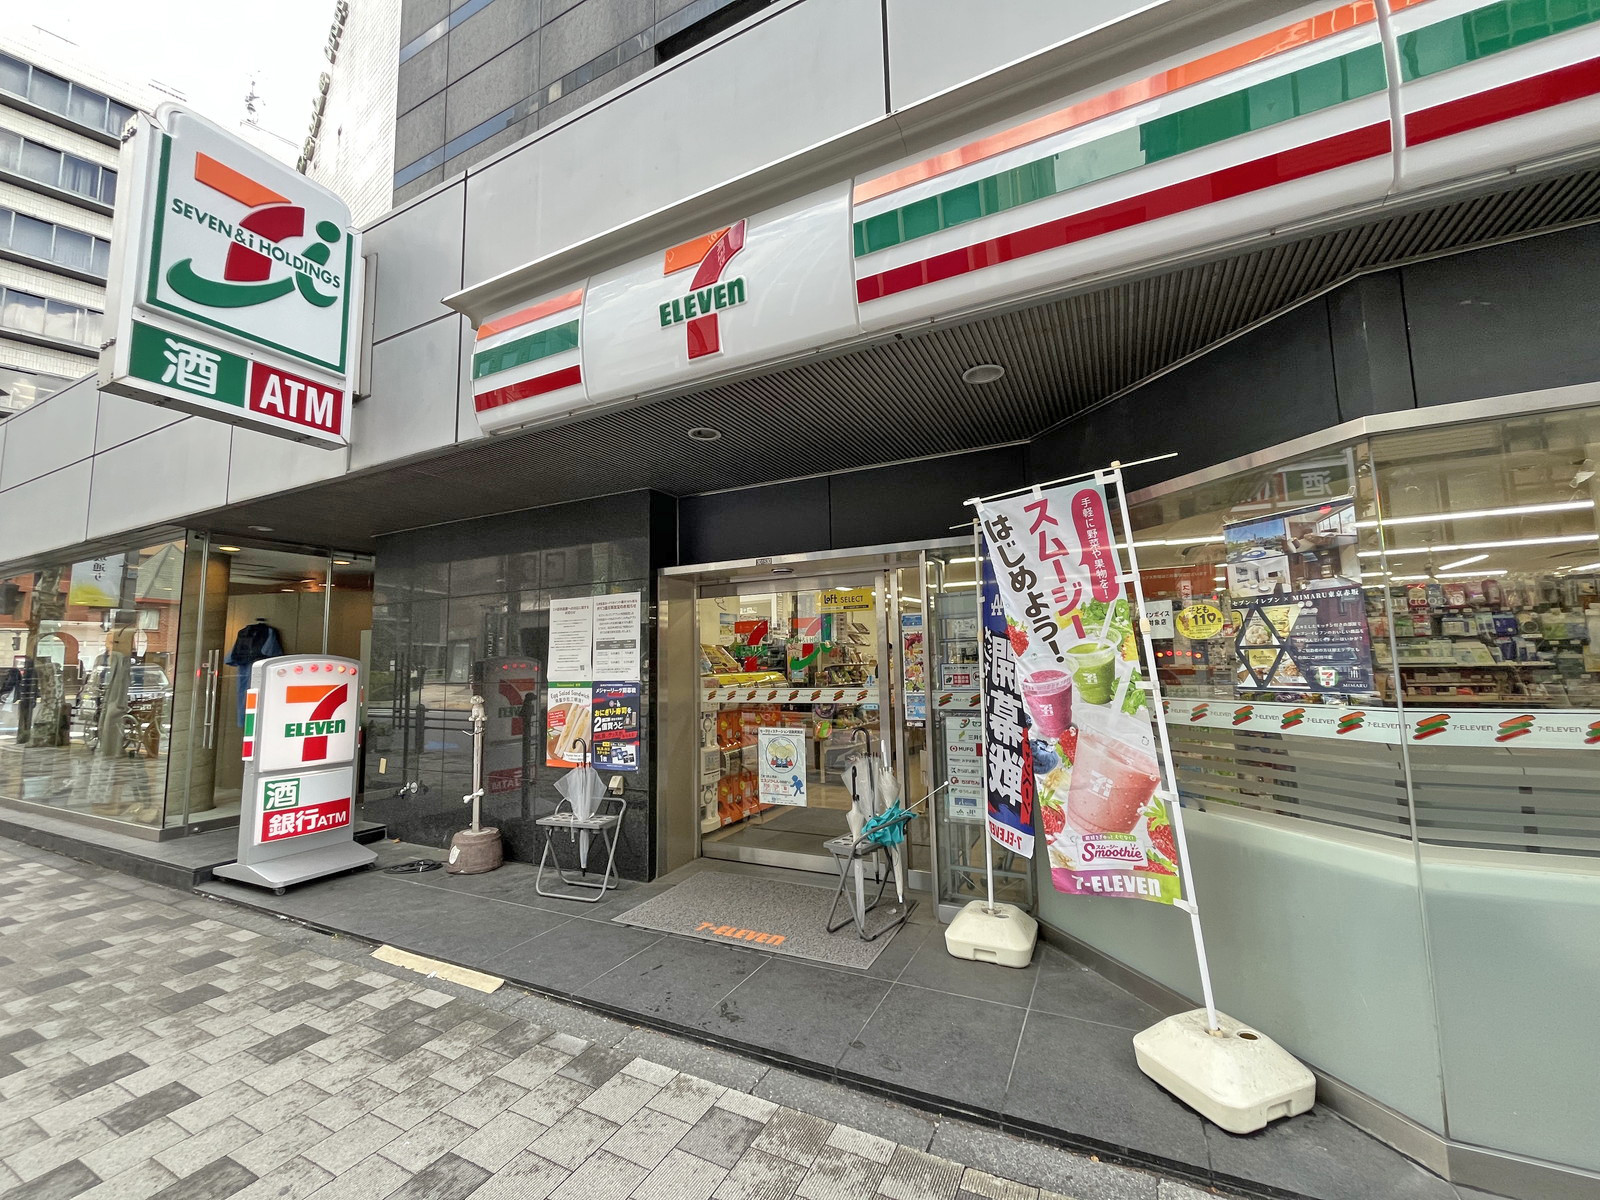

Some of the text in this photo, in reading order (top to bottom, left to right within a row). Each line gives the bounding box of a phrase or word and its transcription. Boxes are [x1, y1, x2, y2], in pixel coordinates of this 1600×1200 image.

[259, 242, 341, 289] HOLDINGS
[161, 337, 222, 396] 酒
[259, 373, 334, 428] ATM
[984, 513, 1065, 663] はじめよう!
[1023, 498, 1086, 640] スムージー
[840, 595, 863, 603] SELECT
[266, 781, 298, 809] 酒
[1081, 842, 1143, 863] Smoothie
